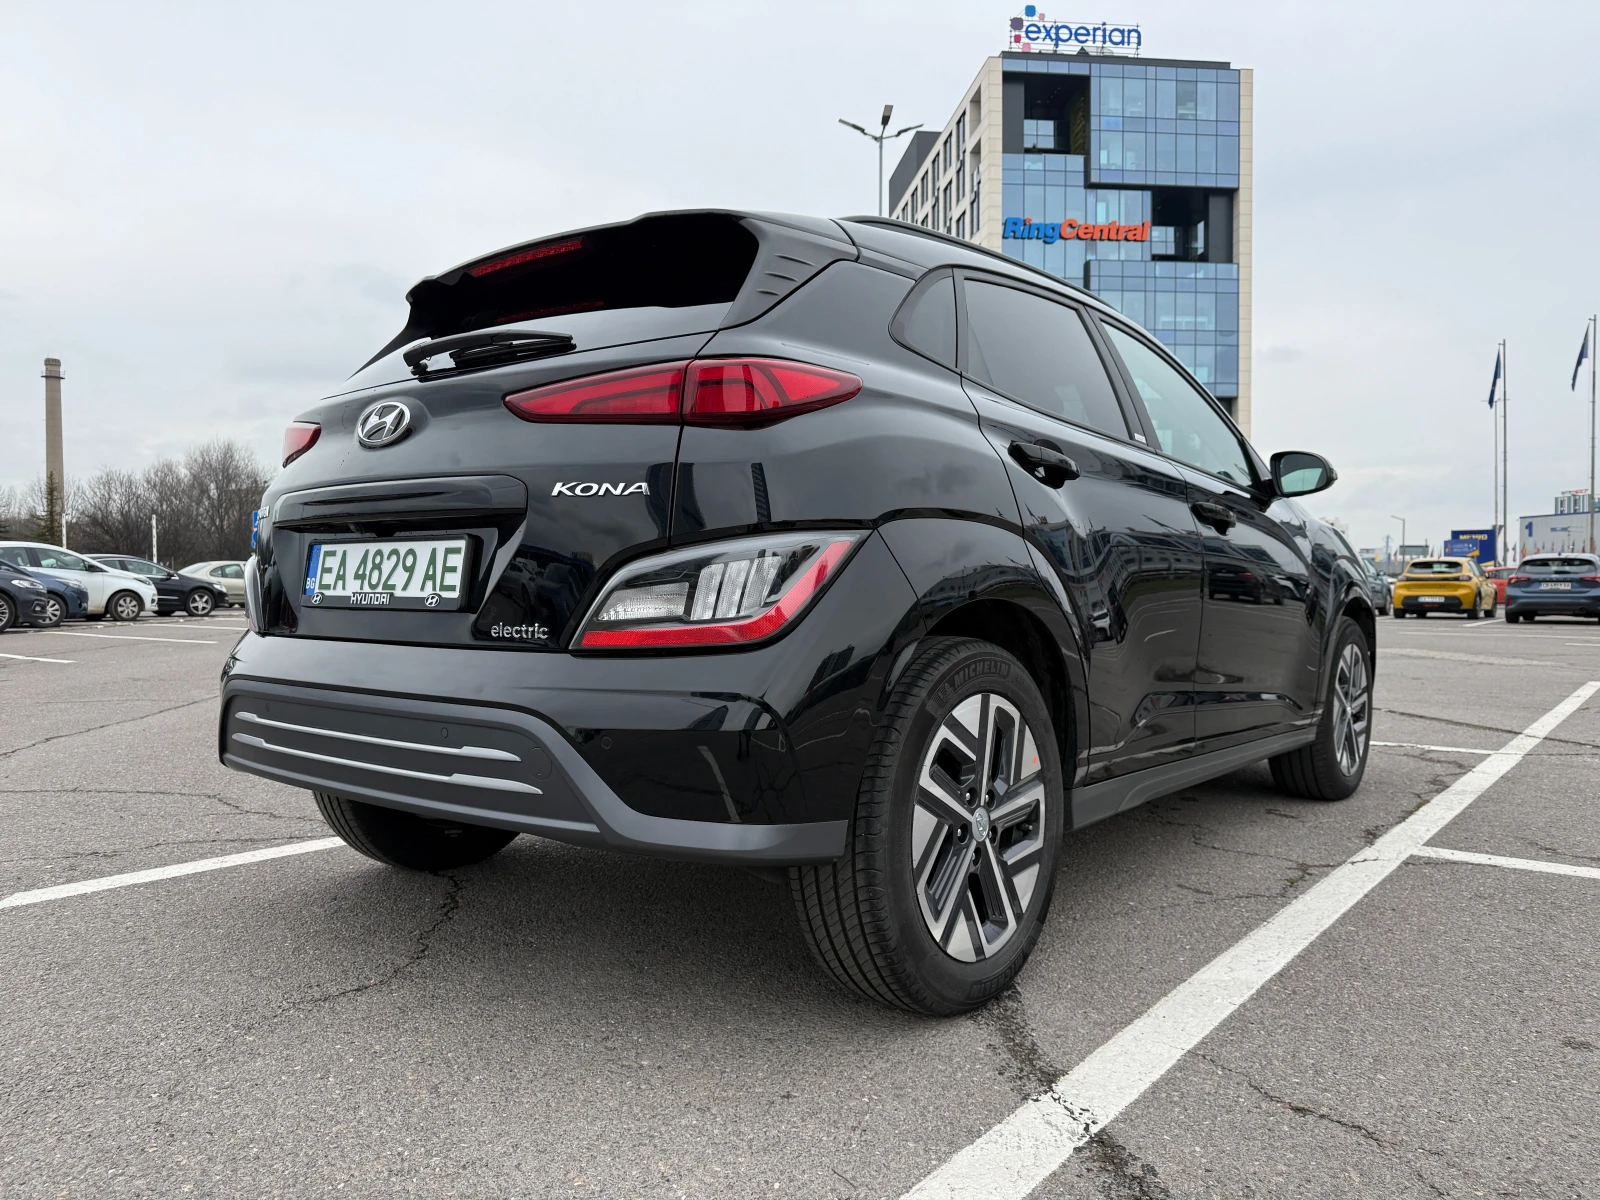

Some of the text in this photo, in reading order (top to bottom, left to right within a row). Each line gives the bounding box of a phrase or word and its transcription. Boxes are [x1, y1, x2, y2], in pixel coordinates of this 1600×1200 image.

[1024, 22, 1142, 48] experian
[1003, 217, 1150, 244] RingCentral
[551, 481, 651, 497] KONA
[1525, 521, 1533, 537] 1
[318, 547, 462, 592] EA 4829 AE
[305, 577, 316, 588] BG
[350, 592, 391, 605] HYUNDAI
[490, 622, 550, 640] electric
[954, 663, 1008, 688] MICHELIN
